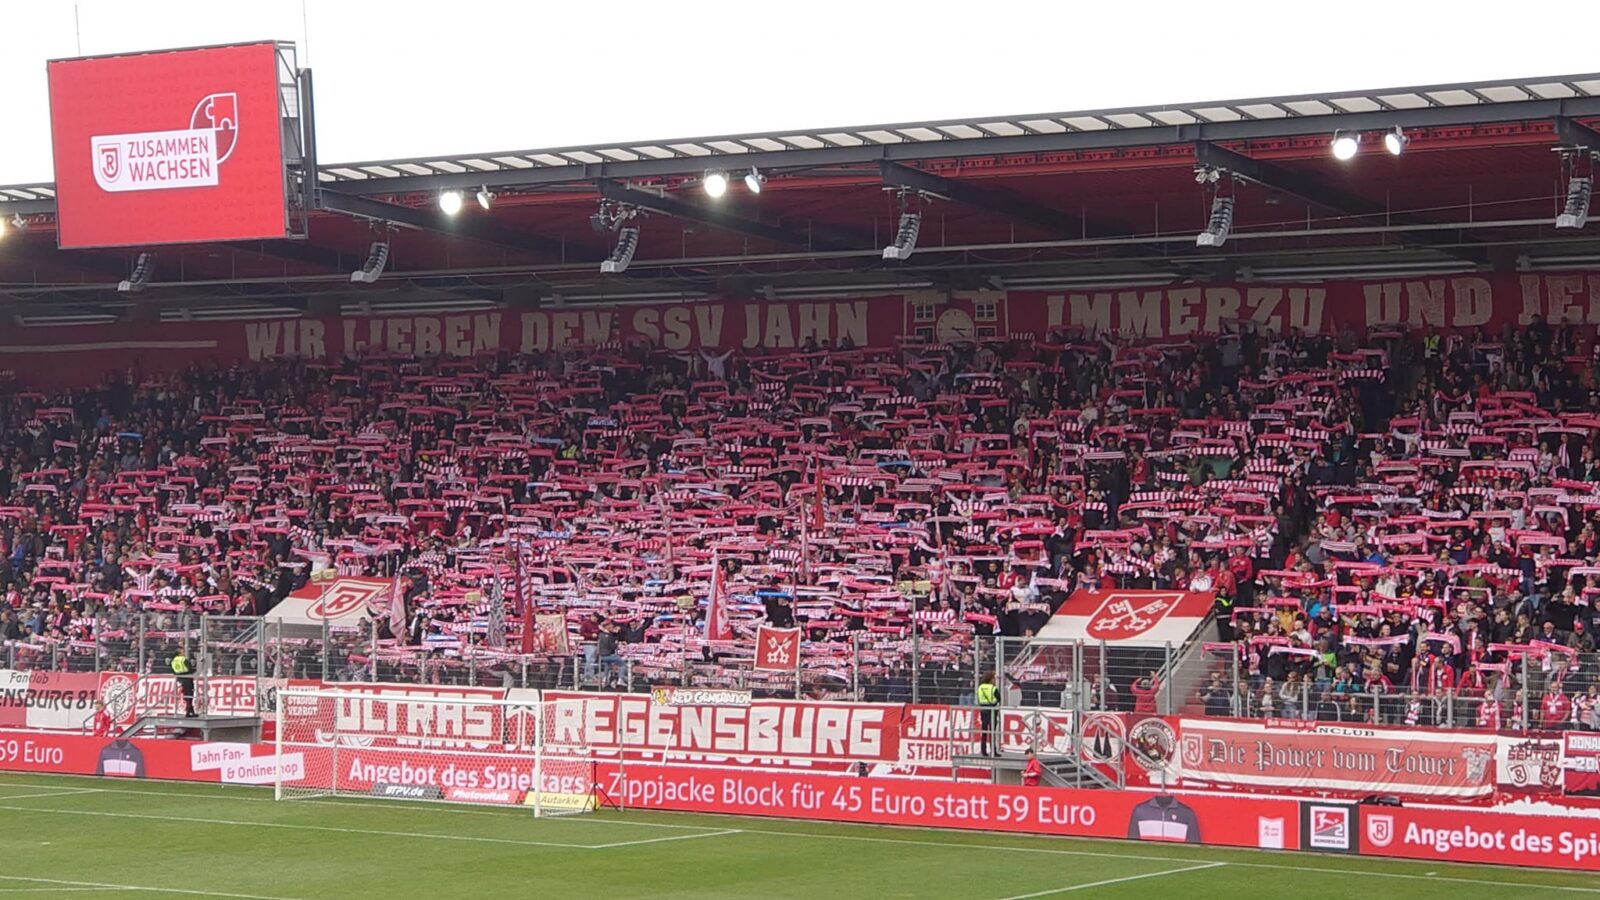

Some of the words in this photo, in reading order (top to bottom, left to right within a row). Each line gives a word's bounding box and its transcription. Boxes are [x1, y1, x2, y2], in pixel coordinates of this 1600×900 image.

[128, 136, 208, 158] ZUSAMMEN
[129, 158, 210, 182] WACHSEN
[246, 320, 325, 362] WIR
[343, 313, 501, 360] LIEBEN
[520, 311, 612, 354] DEN
[633, 303, 724, 350] SSV
[744, 301, 869, 348] JAHN
[1047, 287, 1326, 340] IMMERZU
[1363, 277, 1493, 329] UND
[10, 672, 49, 684] Fanclub
[76, 690, 97, 709] 81
[336, 688, 493, 737] ULTRAS
[555, 698, 884, 756] REGENSBURG
[907, 709, 972, 739] JAHN
[24, 741, 63, 765] Euro
[197, 750, 220, 763] Jahn
[223, 748, 244, 760] Fan-
[1208, 738, 1246, 764] Die
[1253, 740, 1325, 772] Power
[1384, 747, 1459, 776] Tower
[227, 767, 235, 779] &
[349, 757, 437, 785] Angebot
[441, 763, 479, 787] des
[483, 765, 585, 794] Spieltags
[607, 771, 715, 808] Zippjacke
[722, 777, 784, 808] Block
[791, 782, 824, 810] für
[832, 787, 861, 811] 45
[871, 790, 925, 816] Euro
[933, 793, 989, 820] statt
[997, 795, 1029, 822] 59
[1038, 799, 1096, 826] Euro
[541, 794, 579, 806] Autarkie
[1404, 822, 1506, 853] Angebot
[1510, 829, 1553, 853] des
